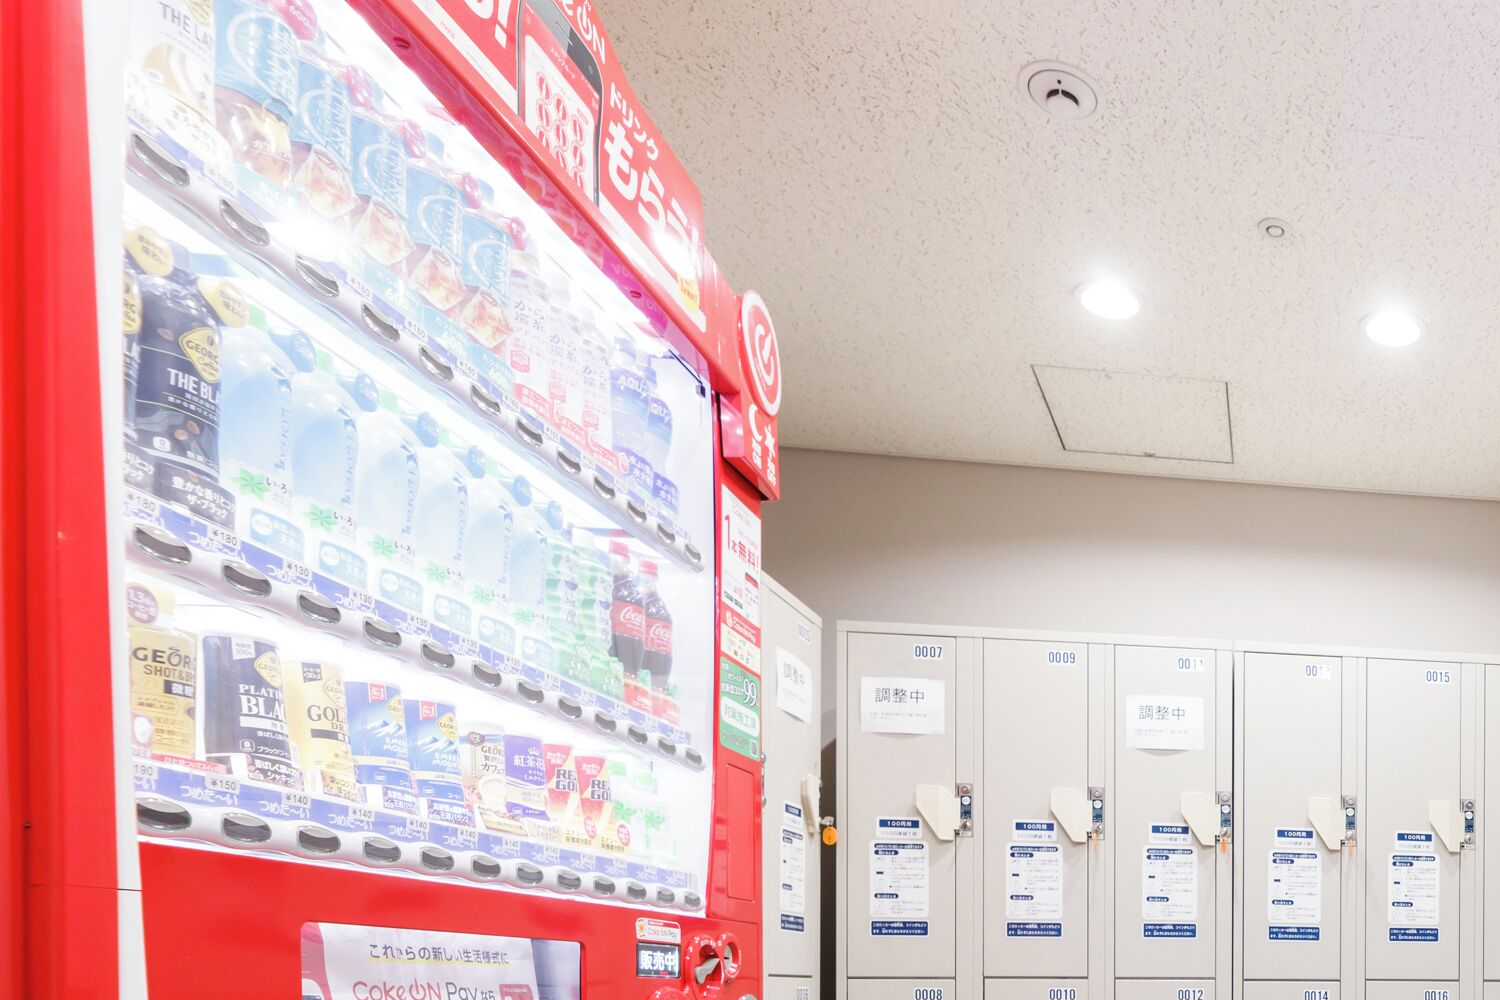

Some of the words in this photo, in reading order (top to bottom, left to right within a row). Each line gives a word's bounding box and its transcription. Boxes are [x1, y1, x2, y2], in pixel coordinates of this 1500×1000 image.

[159, 1, 191, 33] THE
[610, 81, 659, 161] ドリンク
[167, 367, 199, 396] THE
[287, 561, 310, 577] ¥130
[352, 591, 373, 606] ¥130
[410, 615, 428, 628] ¥130
[914, 645, 943, 659] 0007
[1047, 651, 1077, 665] 0009
[1425, 670, 1451, 684] 0015
[873, 687, 926, 704] 調整中
[1137, 704, 1186, 722] 調整中
[210, 778, 237, 792] ¥150
[285, 793, 308, 806] ¥140
[352, 808, 372, 820] ¥140
[409, 819, 428, 830] ¥140
[459, 829, 476, 840] ¥140
[504, 839, 519, 849] ¥140
[369, 943, 510, 965] これからの新しい生活様式に
[639, 950, 675, 971] 販売中
